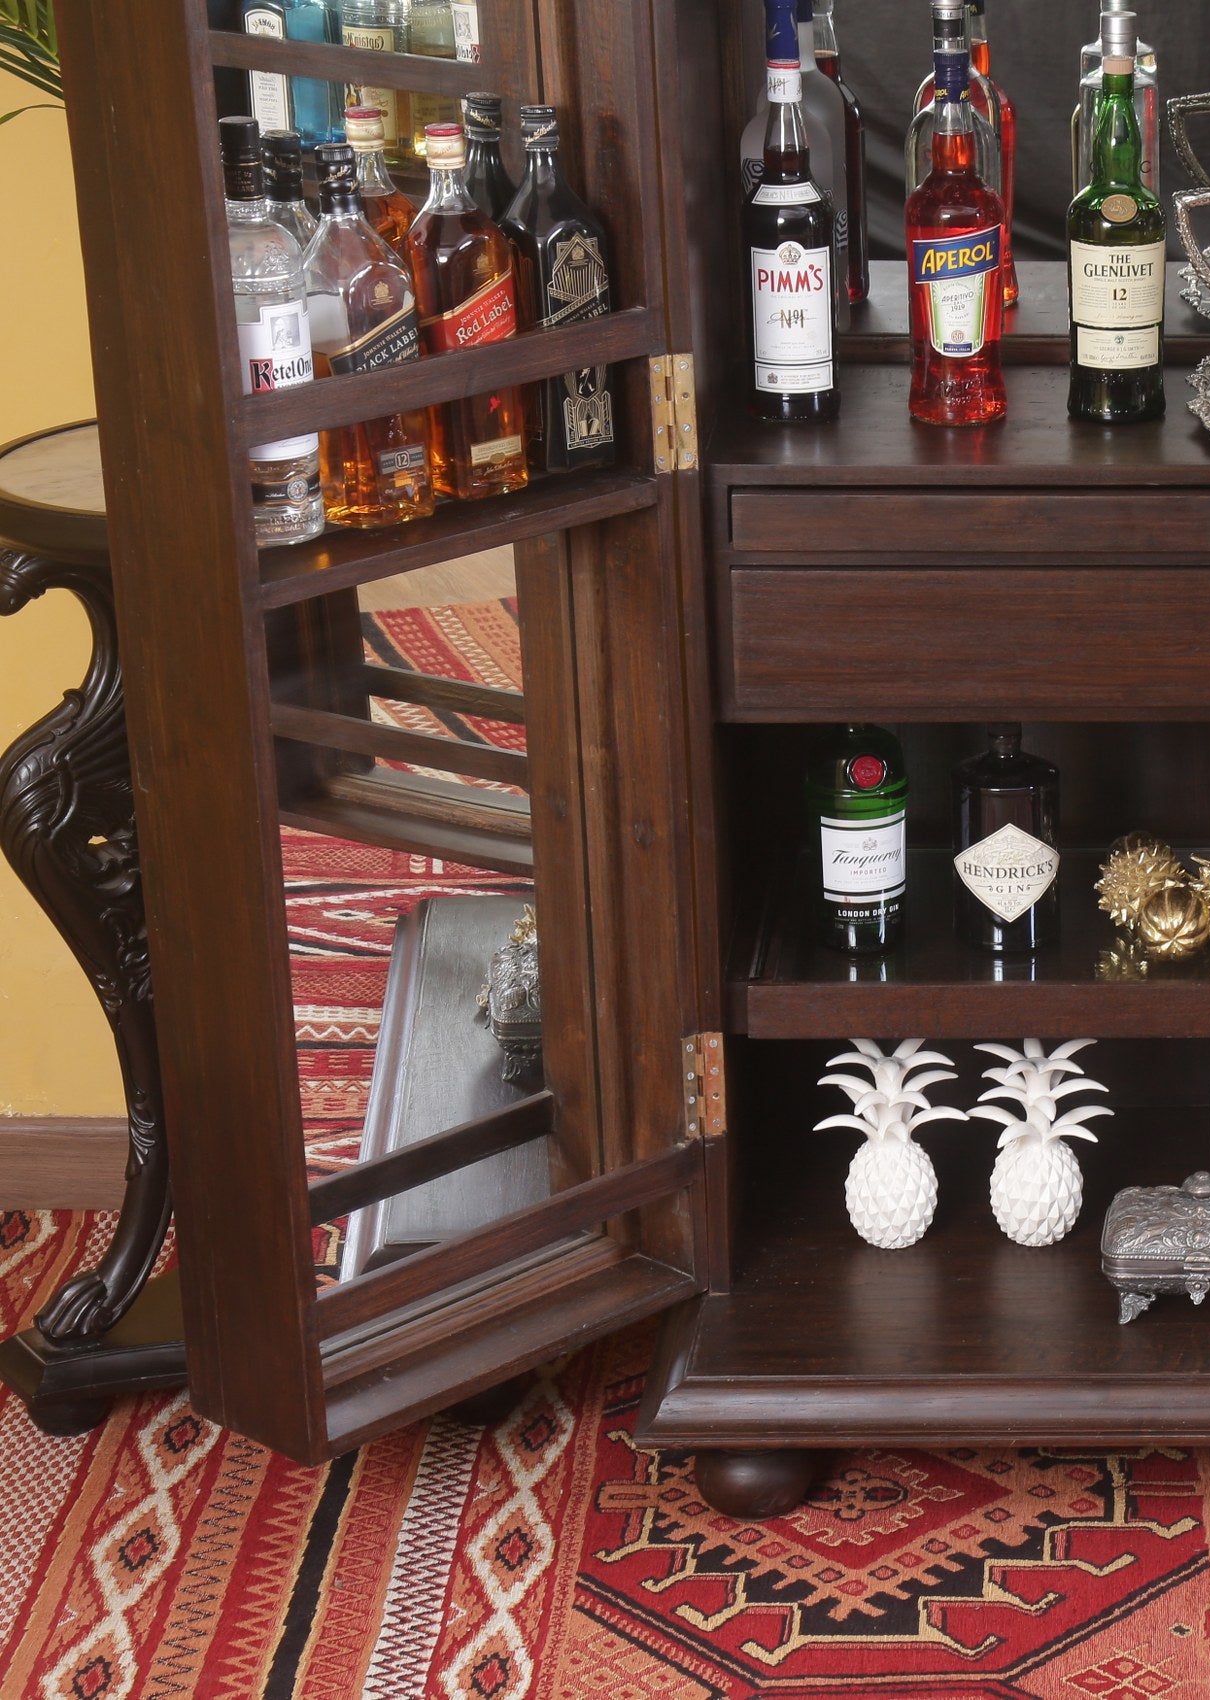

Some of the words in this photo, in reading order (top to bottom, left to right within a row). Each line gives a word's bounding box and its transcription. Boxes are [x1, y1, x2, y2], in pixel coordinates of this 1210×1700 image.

[921, 241, 994, 275] APEROL
[1108, 254, 1132, 264] THE
[757, 263, 824, 293] PIMM'S
[1083, 263, 1154, 278] GLENLIVET
[941, 291, 975, 303] APERITIVO
[1112, 288, 1128, 300] 12
[583, 303, 608, 320] ABEL
[456, 319, 482, 344] Red
[480, 296, 513, 326] Label
[252, 361, 296, 390] Ketel
[397, 453, 408, 467] 12
[832, 847, 902, 869] Tanqueray
[850, 867, 887, 876] IMPORTED
[963, 860, 1054, 879] HENDRICK'S
[995, 884, 1025, 893] GIN
[837, 909, 870, 918] LONDON
[872, 907, 887, 917] DRY
[889, 903, 900, 914] GIN
